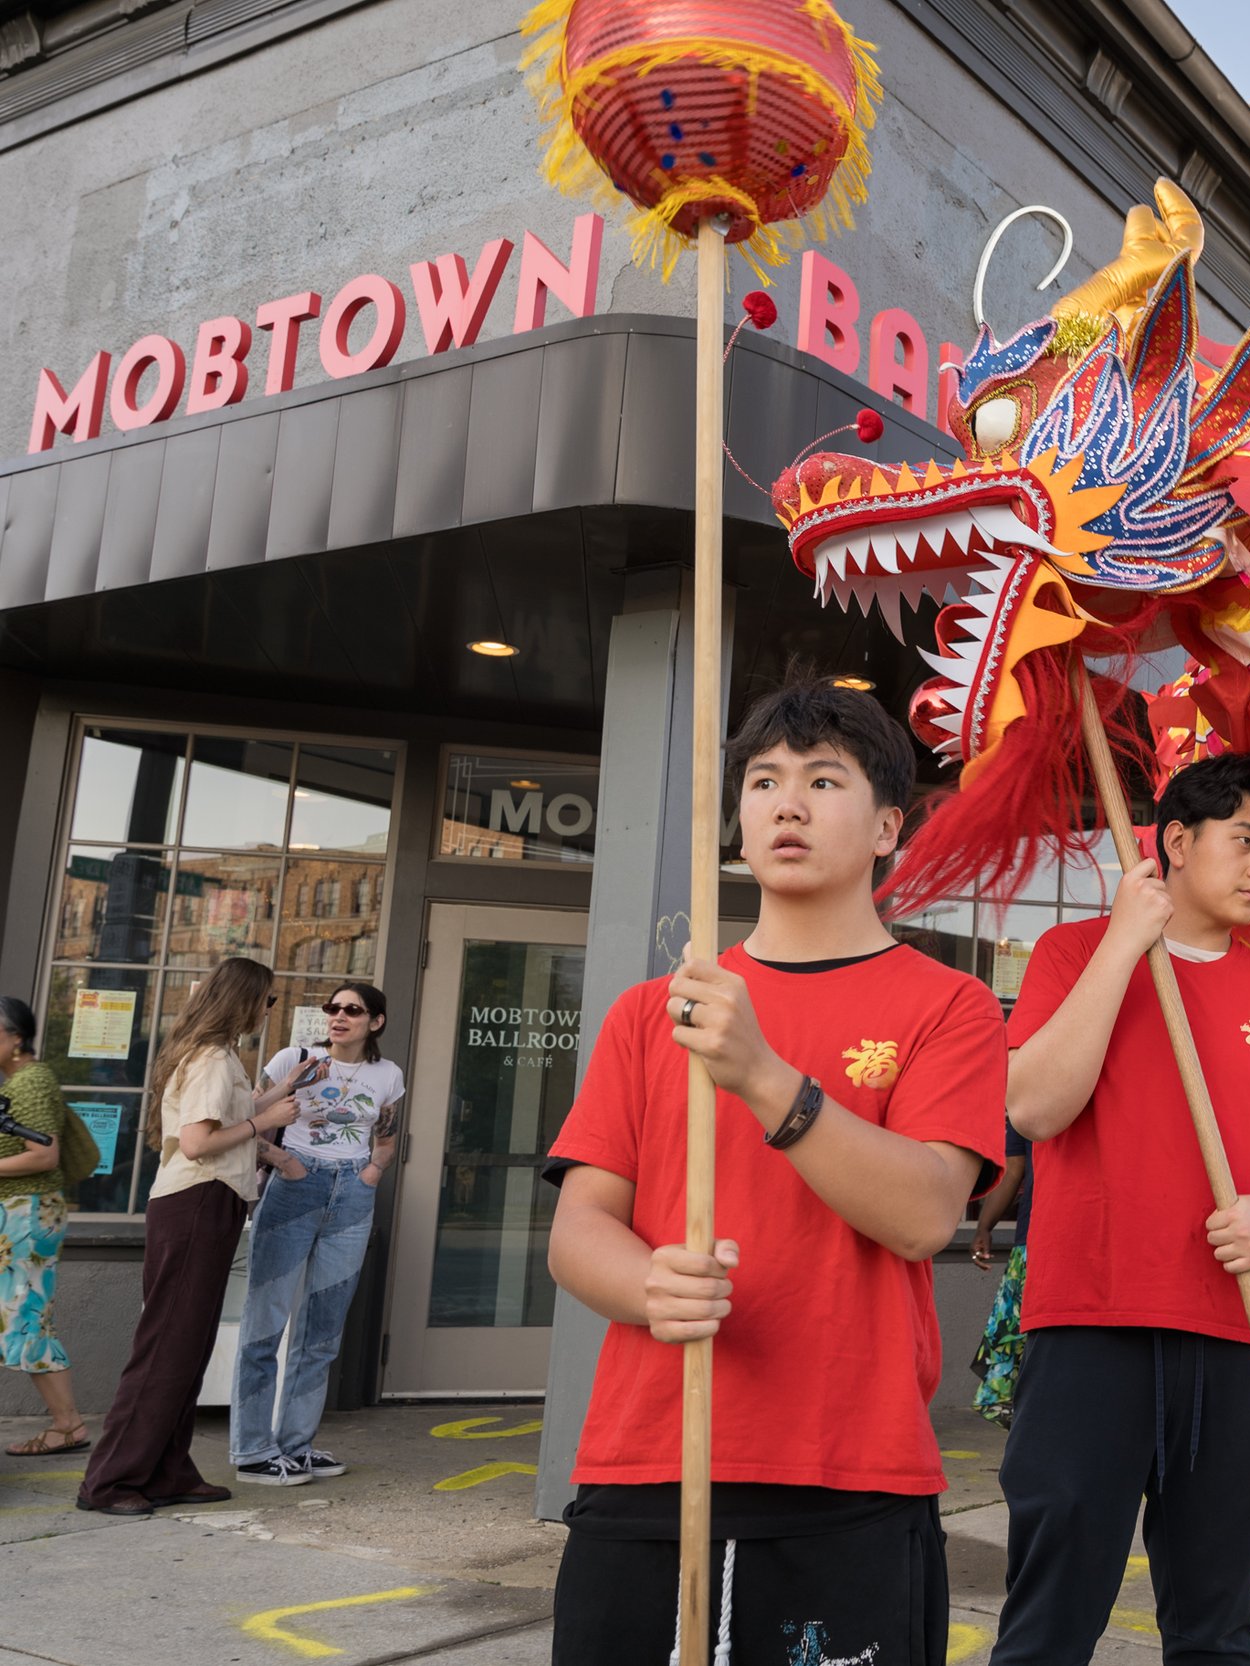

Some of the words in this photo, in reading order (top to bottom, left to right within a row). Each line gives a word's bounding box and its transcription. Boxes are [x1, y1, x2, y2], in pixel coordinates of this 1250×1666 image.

[27, 212, 605, 455] MOBTOWN
[469, 1006, 581, 1027] MOBTOW
[503, 1055, 514, 1067] &
[517, 1054, 553, 1068] CAFÉ
